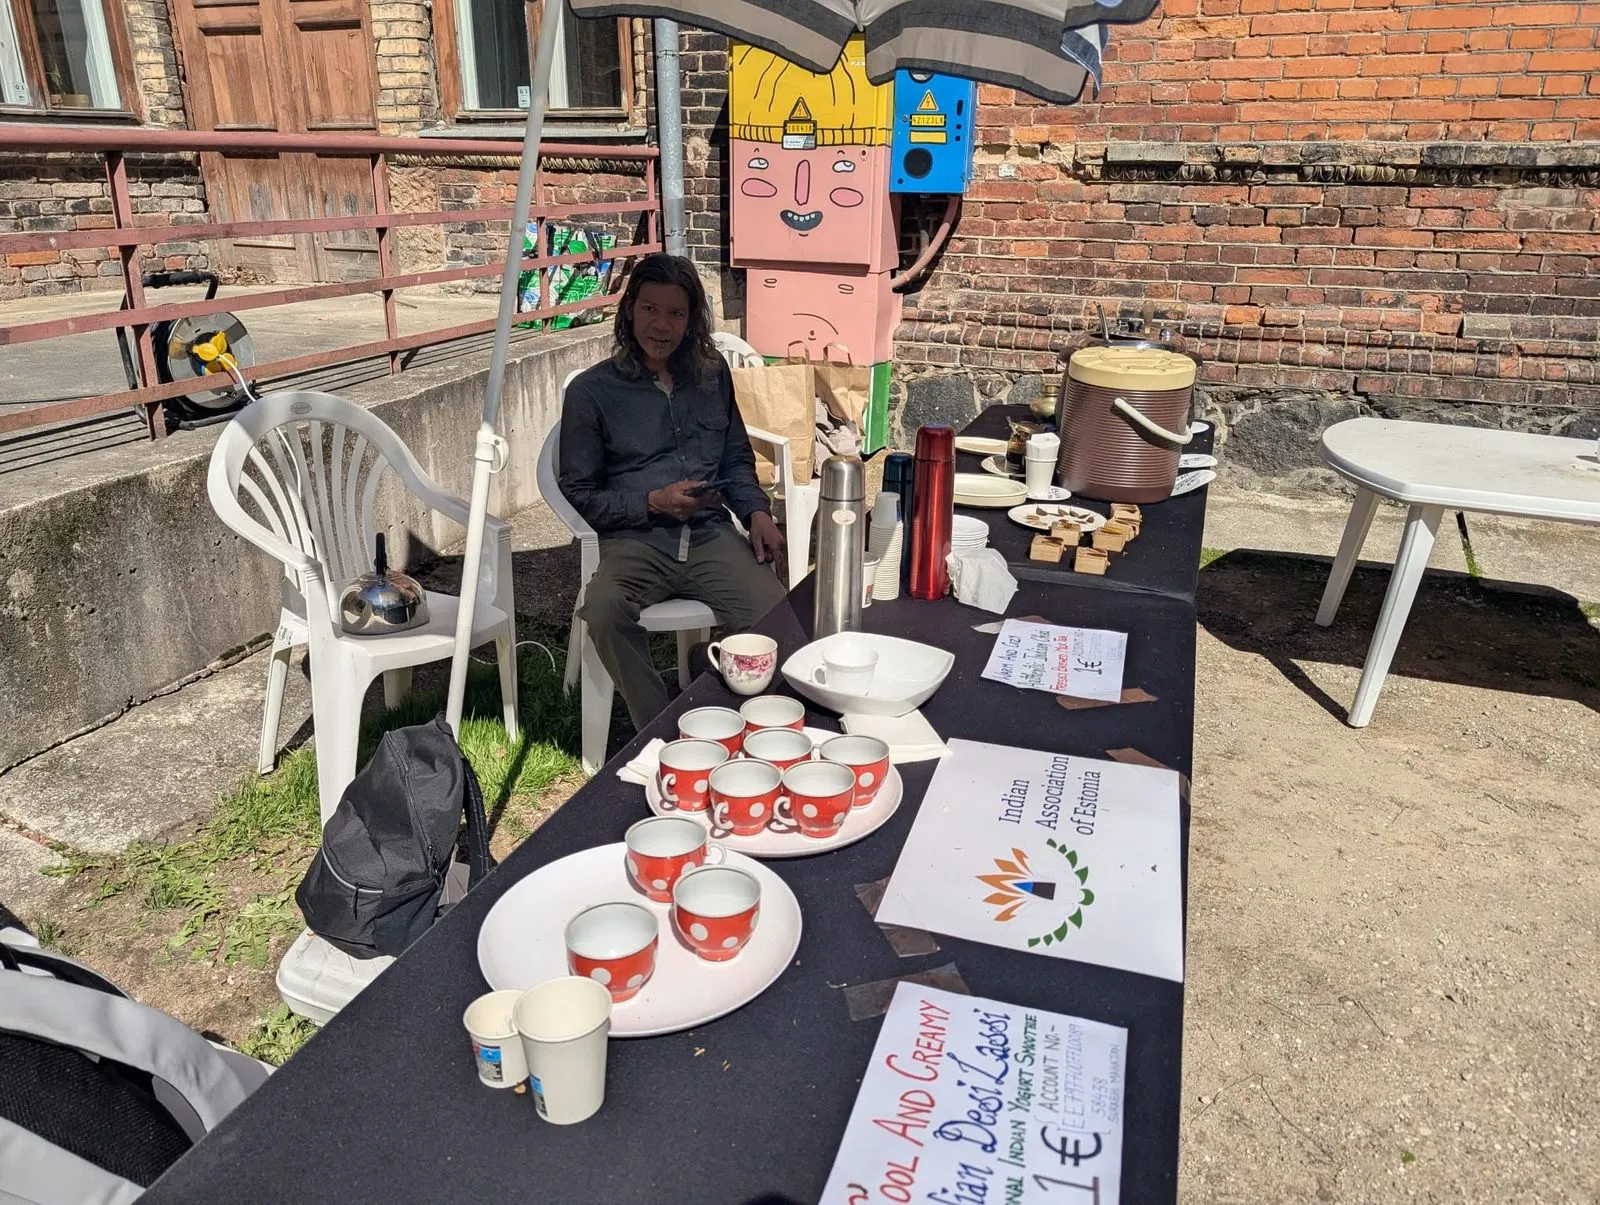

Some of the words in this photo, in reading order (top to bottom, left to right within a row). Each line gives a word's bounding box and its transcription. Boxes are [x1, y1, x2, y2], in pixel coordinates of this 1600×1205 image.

[992, 663, 1014, 680] WARM
[998, 649, 1018, 662] AND
[998, 779, 1029, 824] Indian
[1034, 756, 1069, 830] Association
[1073, 770, 1101, 818] Estonia
[1070, 817, 1095, 836] of
[886, 1000, 950, 1082] CREAMY
[947, 1008, 1011, 1085] Lassi
[1008, 1070, 1036, 1113] YOGURT
[1038, 1055, 1060, 1119] ACCOUNT
[872, 1090, 936, 1147] AND
[933, 1079, 1003, 1153] Desi
[997, 1120, 1026, 1168] INDIAN
[877, 1156, 919, 1205] OOL
